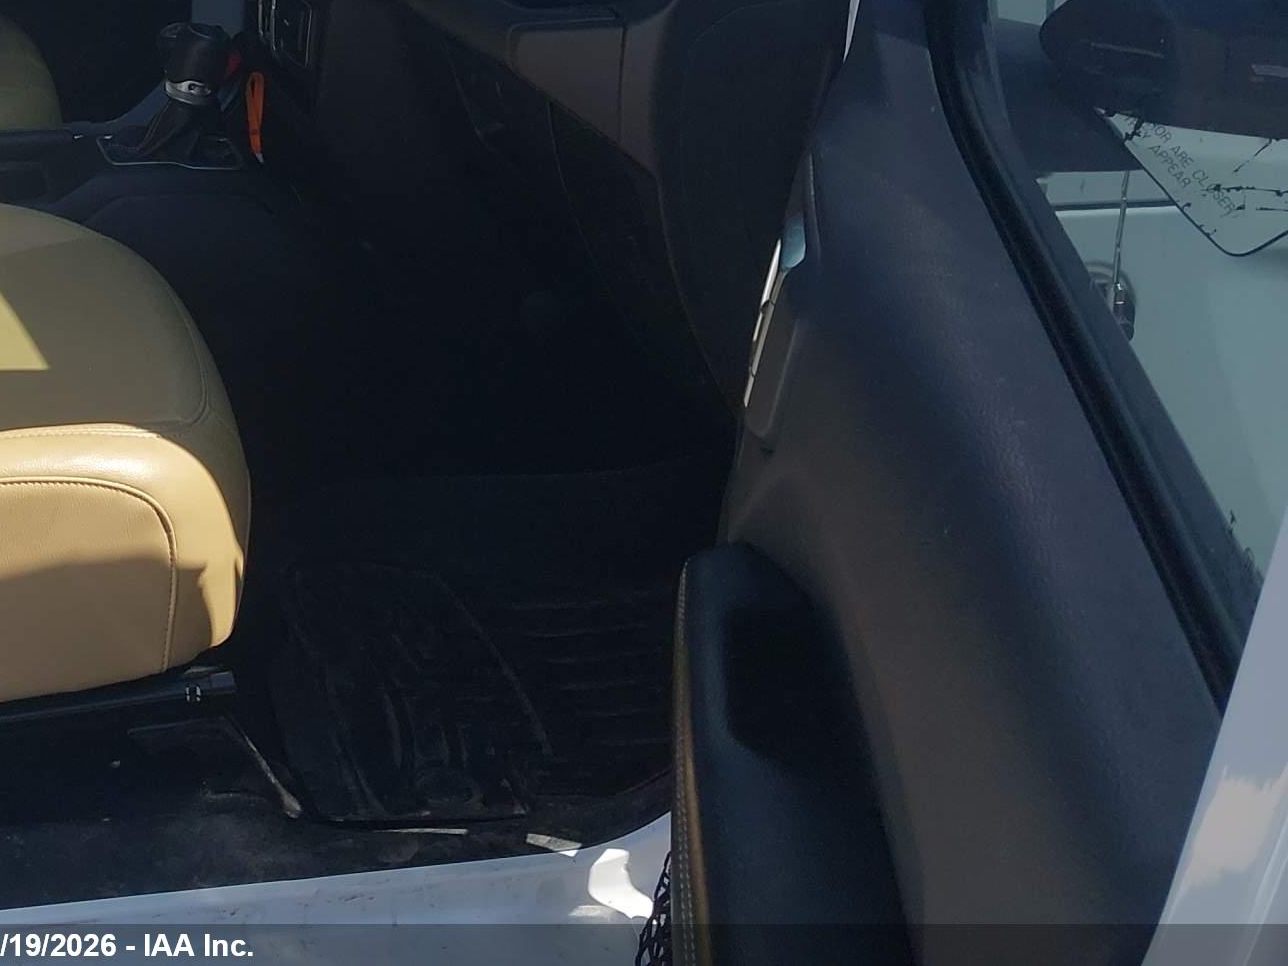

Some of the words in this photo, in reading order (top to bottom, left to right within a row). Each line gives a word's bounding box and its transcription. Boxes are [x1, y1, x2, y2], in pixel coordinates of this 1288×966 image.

[1147, 145, 1191, 188] APPEAR
[1168, 145, 1194, 169] ARE
[1192, 170, 1236, 218] CLOSER
